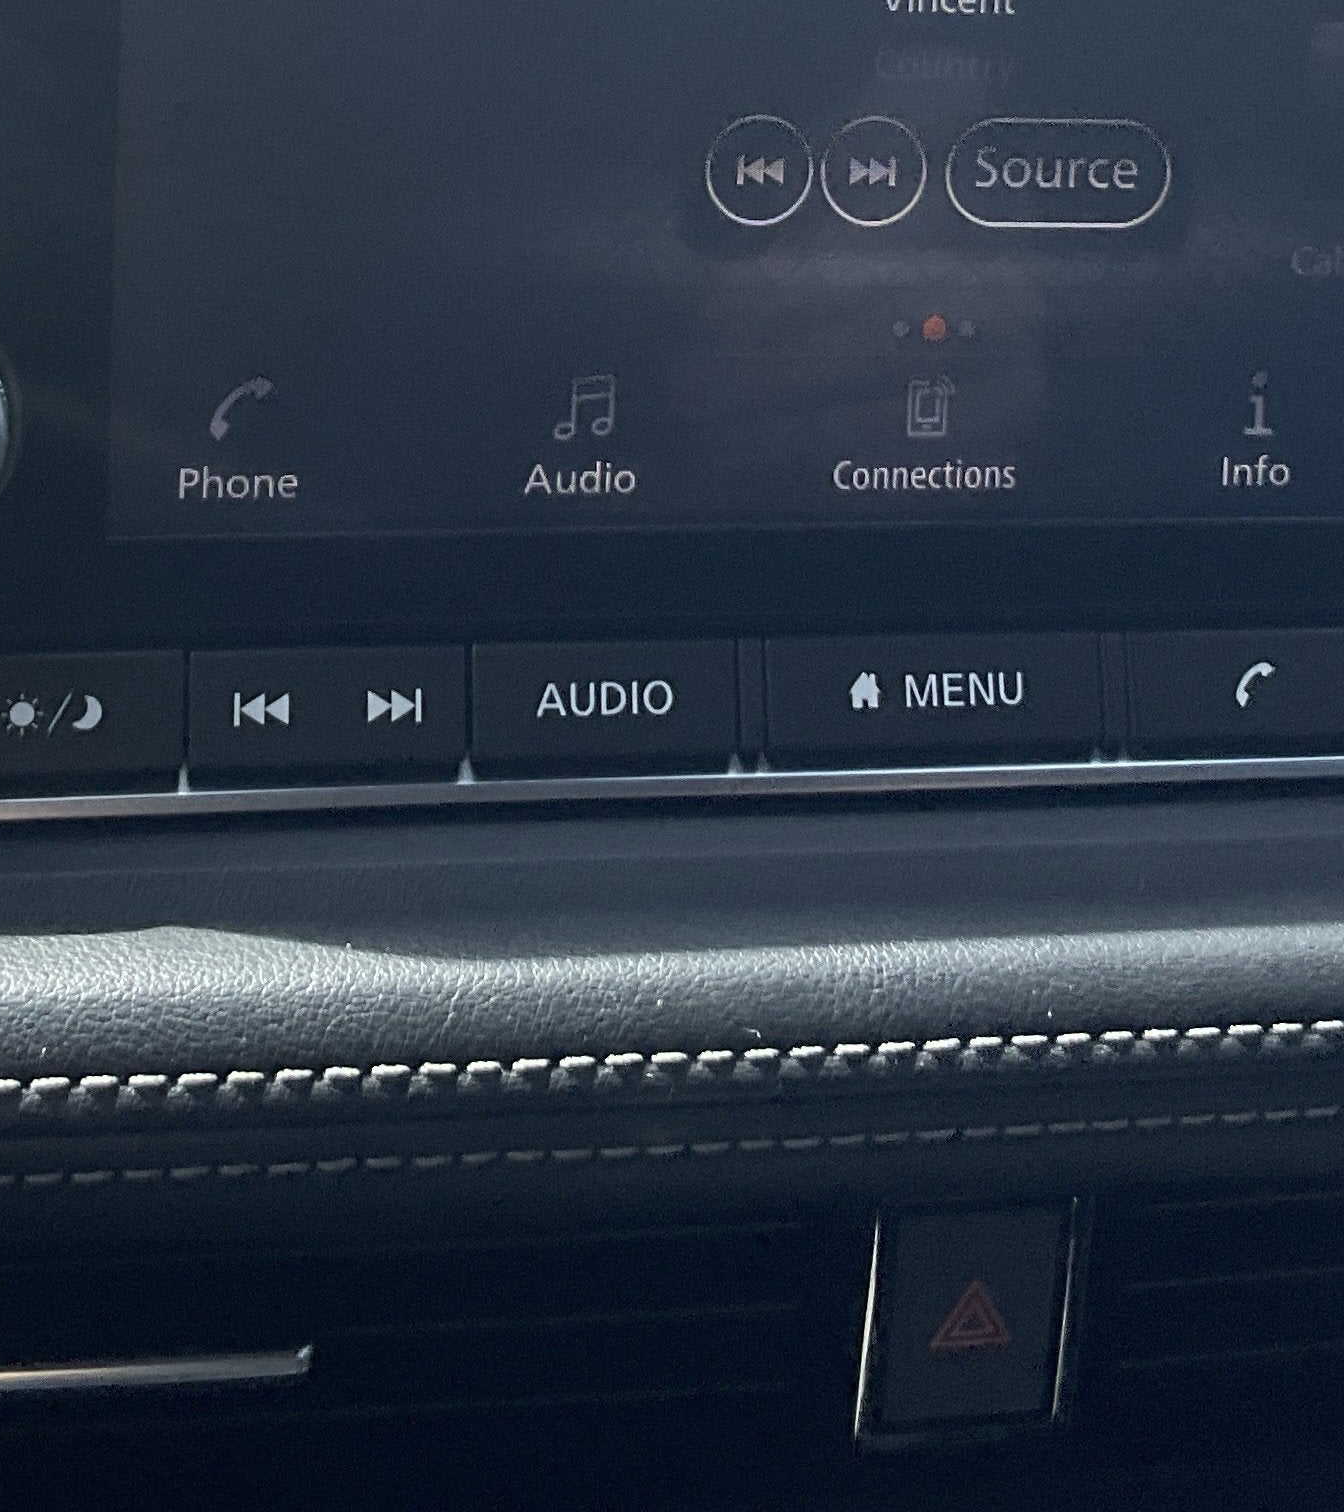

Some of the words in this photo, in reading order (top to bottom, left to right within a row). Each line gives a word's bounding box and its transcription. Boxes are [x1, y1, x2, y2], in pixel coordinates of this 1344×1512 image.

[975, 146, 1138, 189] Source
[178, 465, 299, 500] Phone
[524, 460, 637, 496] Audio
[833, 458, 1017, 490] Connections
[1221, 454, 1292, 488] Info
[538, 680, 674, 717] AUDIO
[905, 672, 1025, 708] MENU
